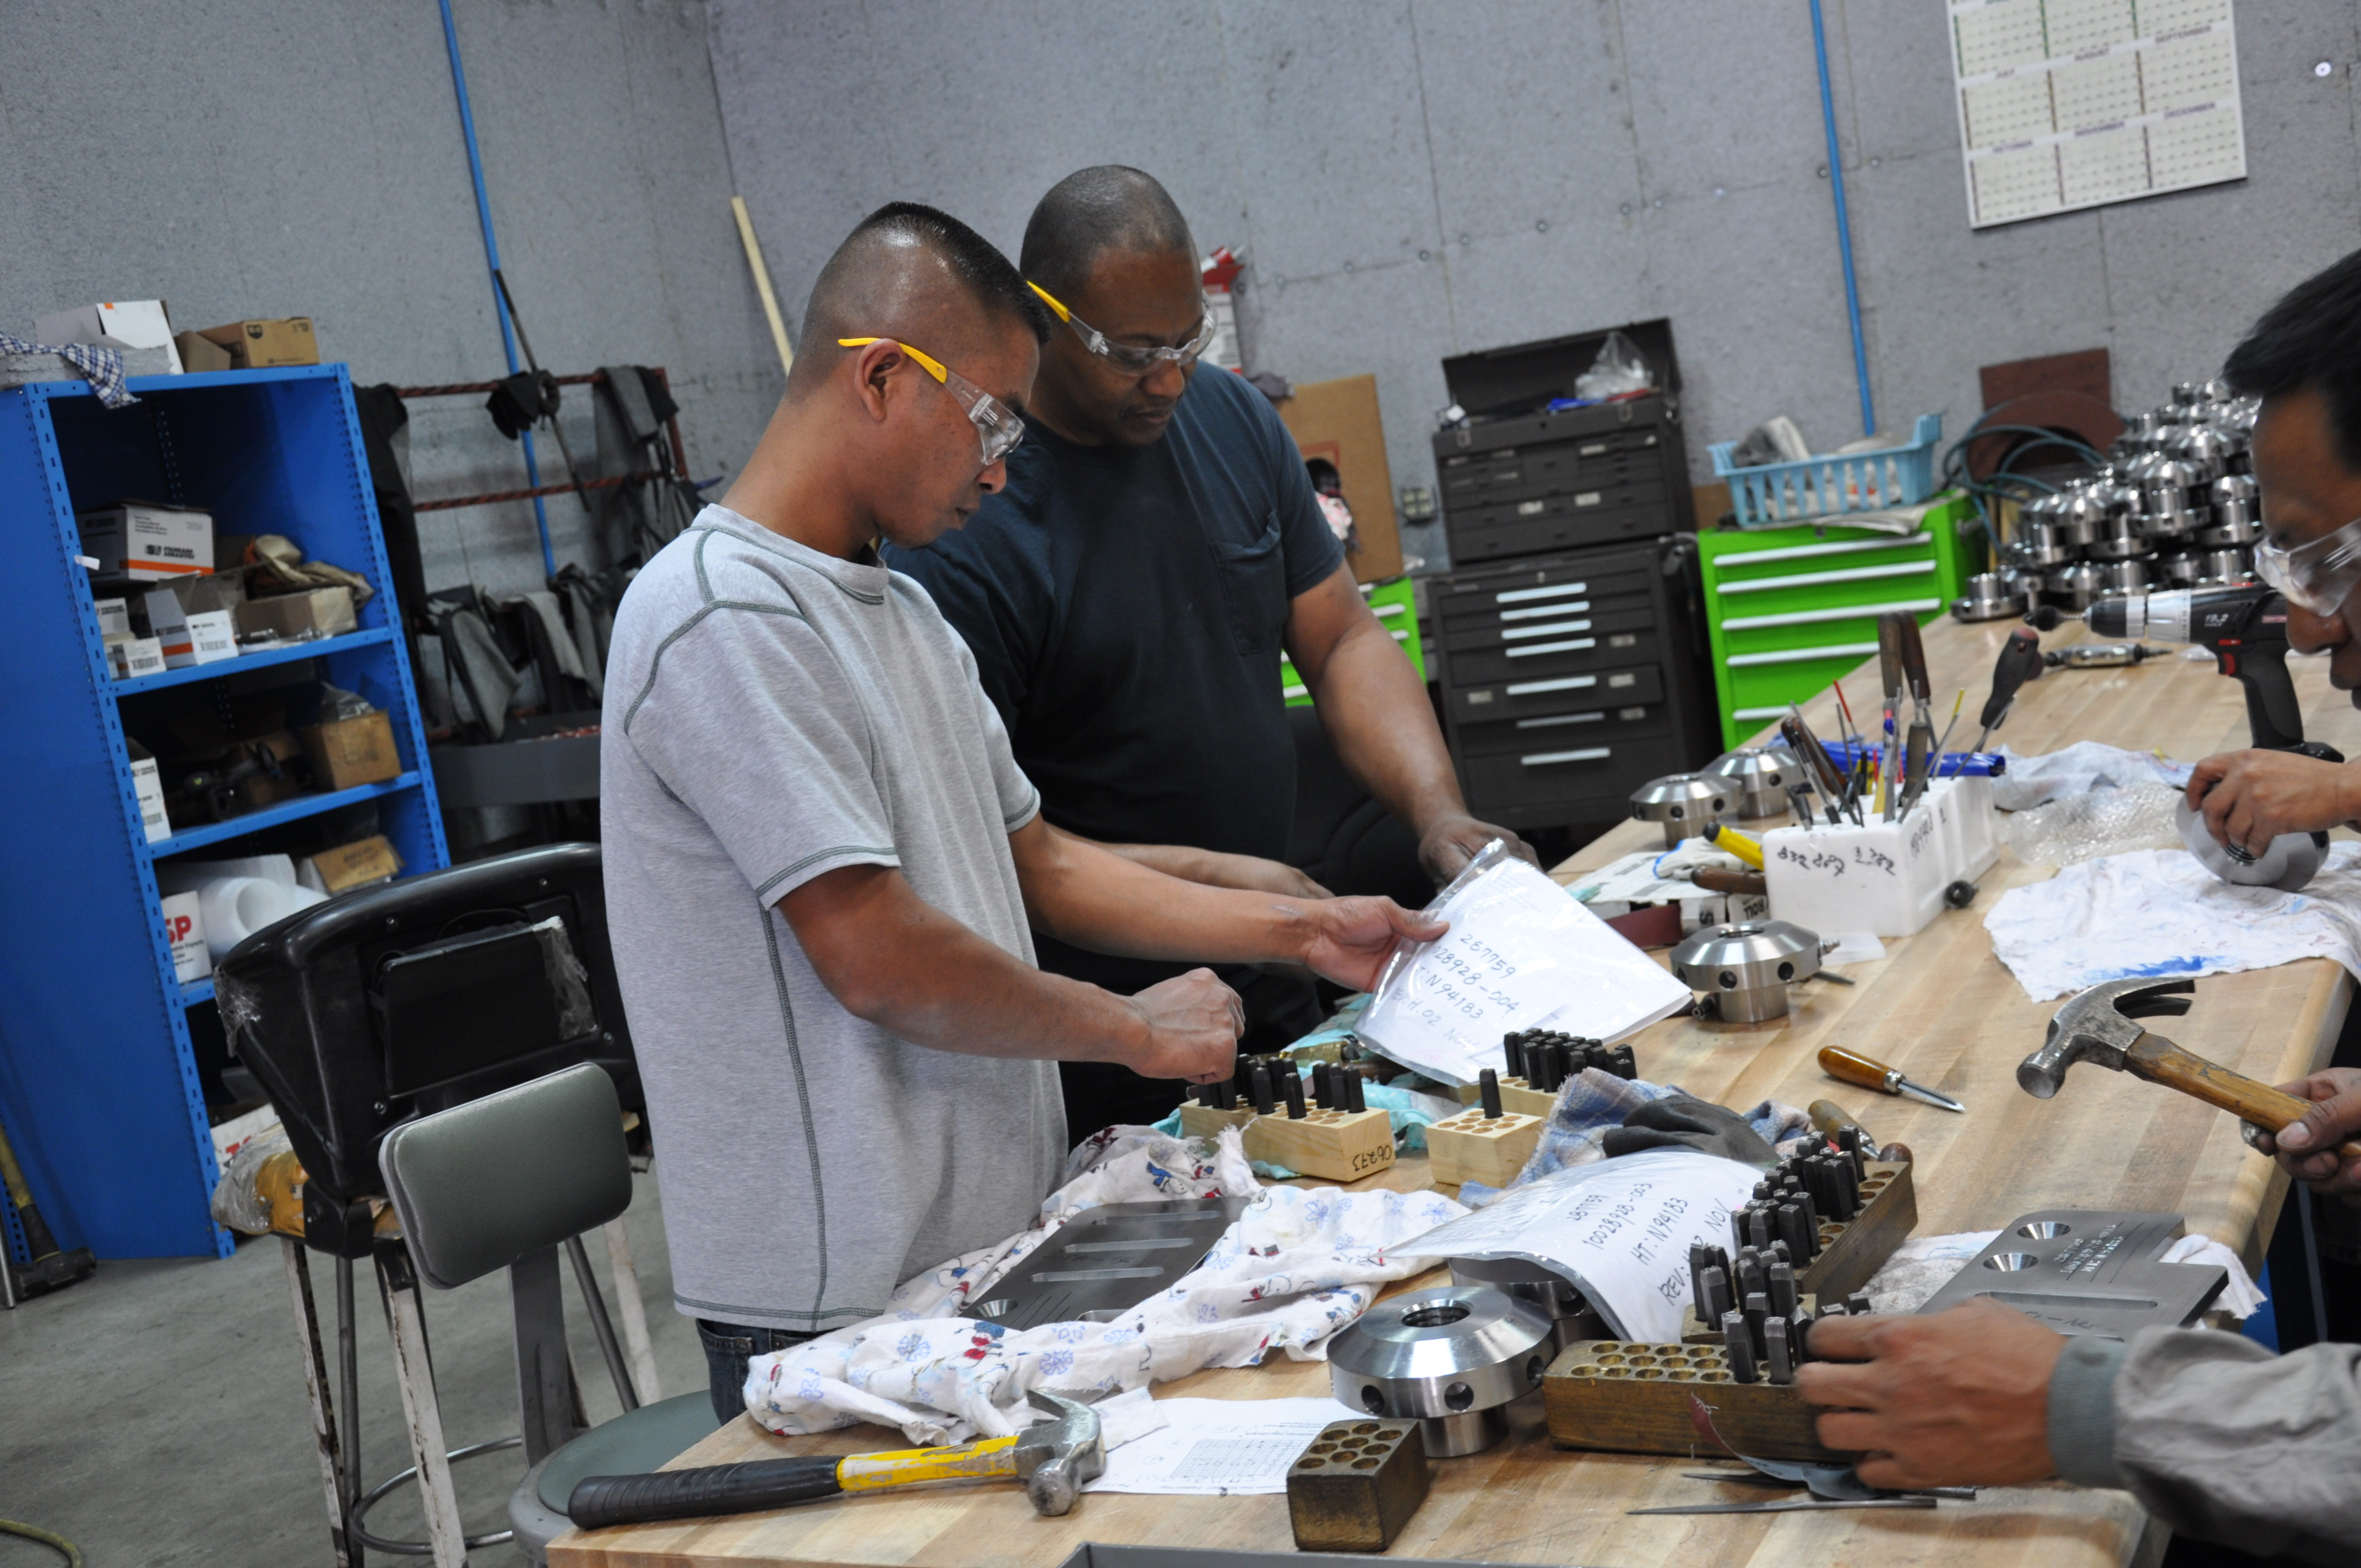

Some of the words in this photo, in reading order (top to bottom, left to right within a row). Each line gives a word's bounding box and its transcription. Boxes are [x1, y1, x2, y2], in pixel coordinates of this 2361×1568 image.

[2155, 25, 2211, 43] SEPTEMBER
[1567, 1194, 1610, 1221] 287759
[1582, 1183, 1652, 1250] 10028928-003
[1646, 1197, 1688, 1242] N94183
[1704, 1197, 1732, 1233] NOV
